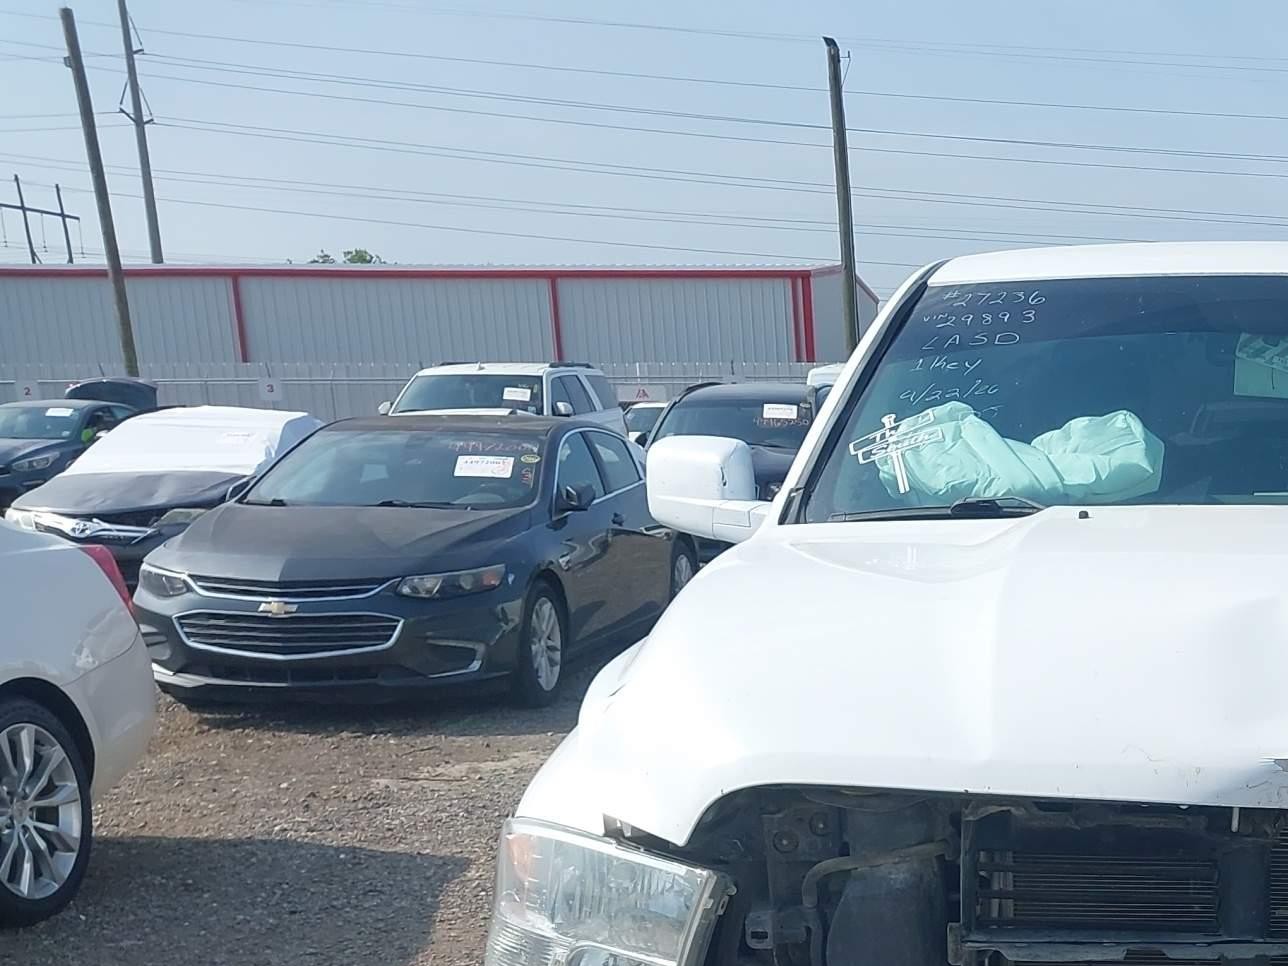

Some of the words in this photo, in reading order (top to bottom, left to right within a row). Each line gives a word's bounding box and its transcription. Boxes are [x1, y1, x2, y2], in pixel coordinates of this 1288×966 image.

[943, 290, 1046, 307] #27236
[922, 332, 1020, 350] LASD
[24, 386, 32, 396] 2
[266, 383, 274, 393] 3
